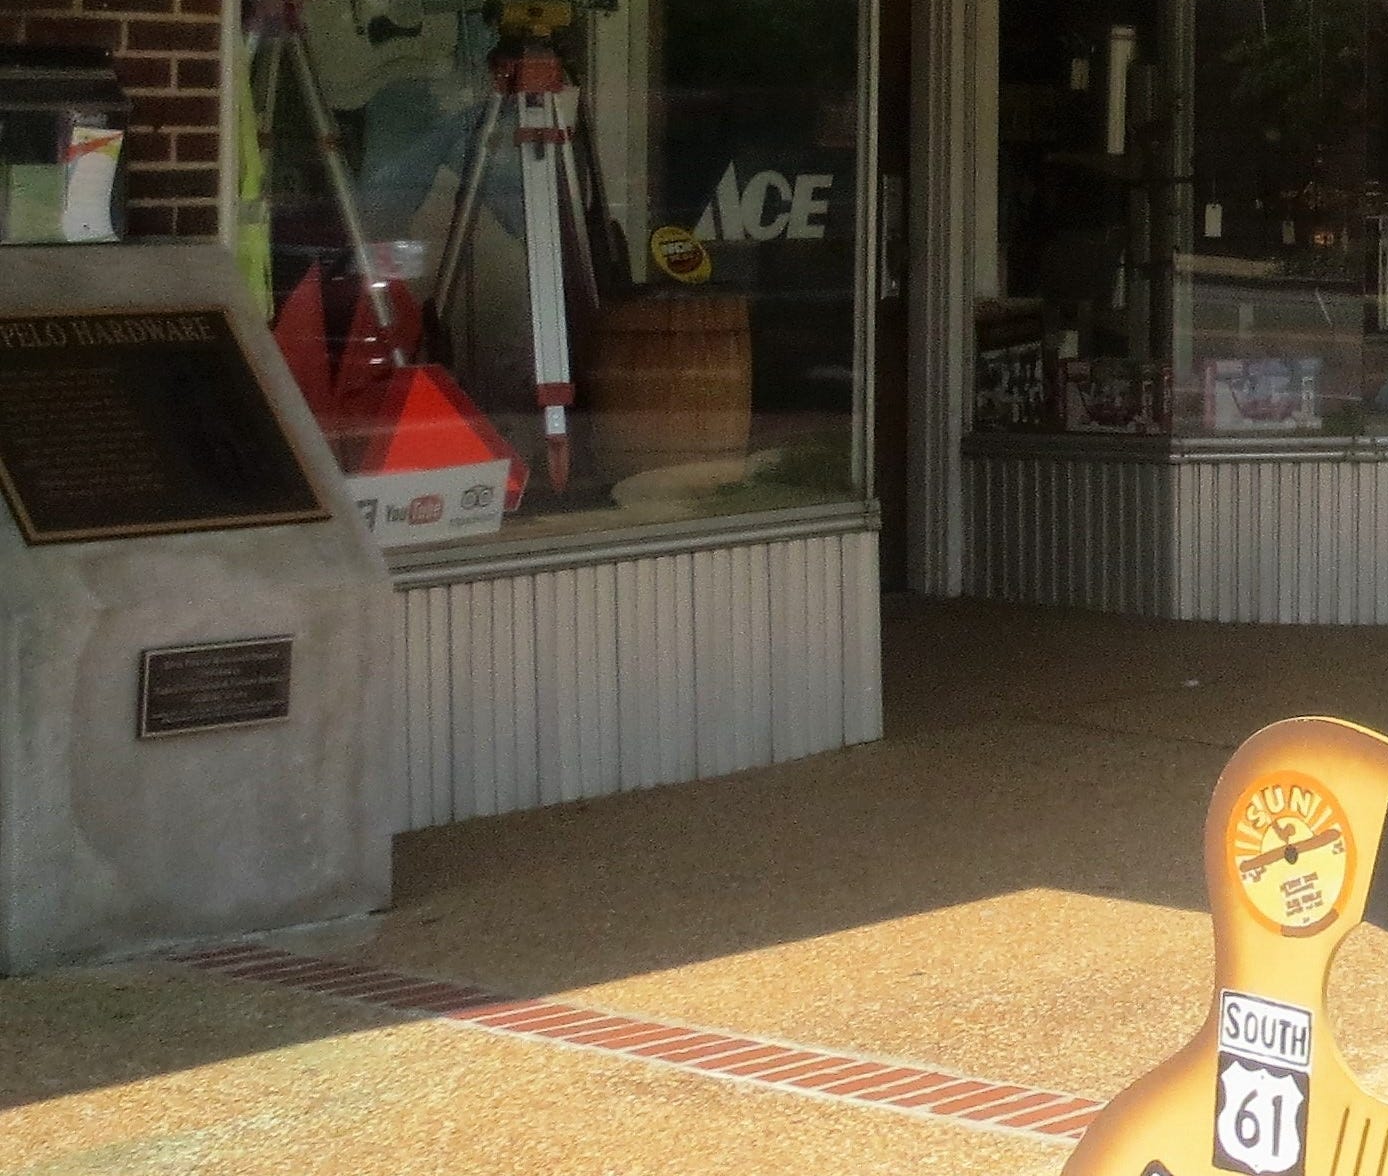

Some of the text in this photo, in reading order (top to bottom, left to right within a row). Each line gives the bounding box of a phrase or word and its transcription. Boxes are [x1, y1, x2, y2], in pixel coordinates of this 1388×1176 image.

[692, 160, 835, 241] ACE
[72, 317, 214, 345] HARDWARE
[1246, 785, 1314, 829] SUN
[1225, 1001, 1308, 1057] SOUTH
[1234, 1089, 1284, 1157] 61
